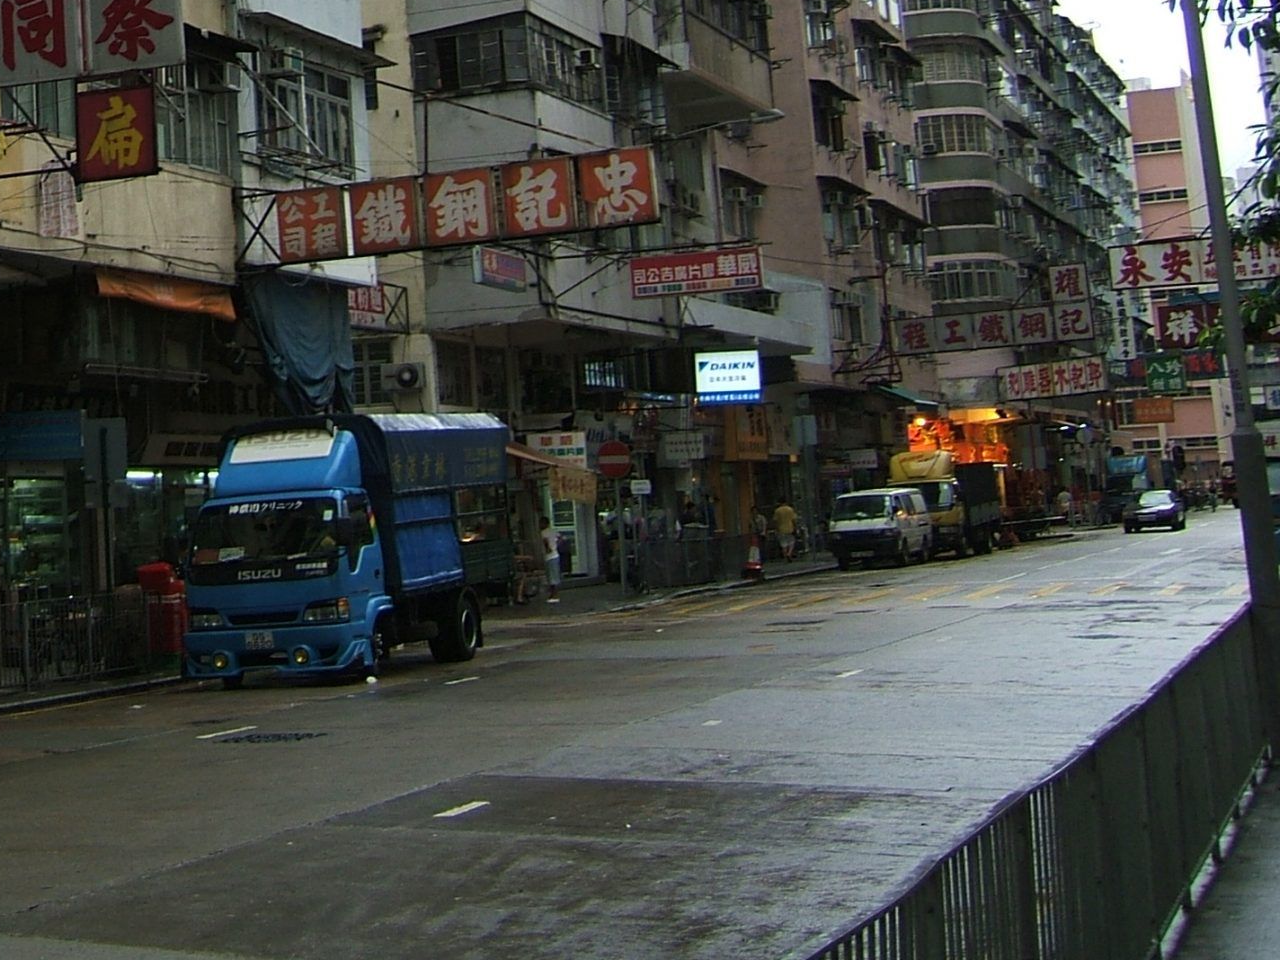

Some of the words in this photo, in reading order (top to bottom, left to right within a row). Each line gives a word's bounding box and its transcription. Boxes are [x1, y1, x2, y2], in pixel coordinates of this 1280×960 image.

[355, 153, 648, 246] 忠記鋼鐵
[1115, 243, 1194, 287] 永安
[710, 361, 756, 371] DAIKIN
[236, 567, 283, 581] ISUZU
